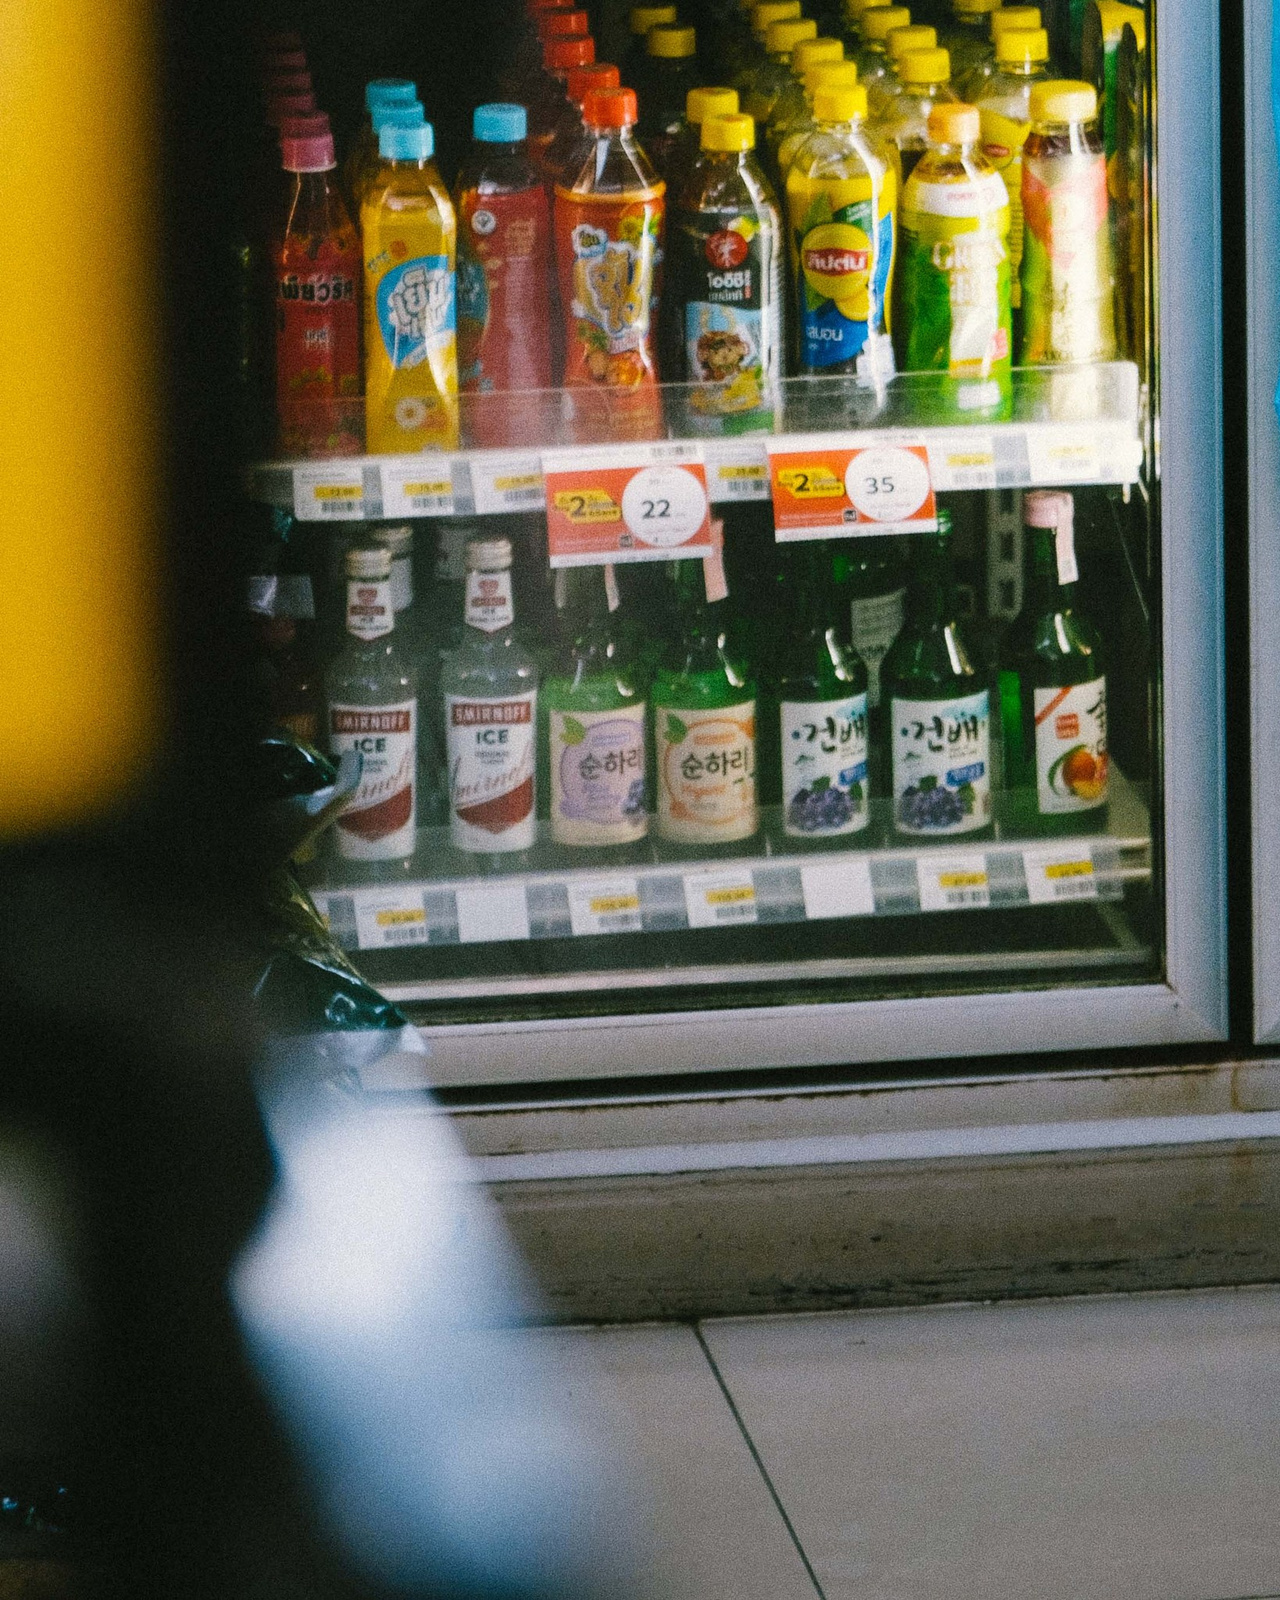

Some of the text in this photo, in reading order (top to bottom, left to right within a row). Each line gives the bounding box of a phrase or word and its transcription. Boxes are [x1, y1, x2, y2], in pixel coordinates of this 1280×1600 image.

[793, 473, 811, 493] 2
[865, 475, 895, 495] 35
[569, 496, 586, 517] 2
[641, 499, 671, 519] 22
[456, 703, 528, 722] SMIRNOFF
[353, 737, 386, 753] ICE
[476, 729, 509, 745] ICE
[680, 747, 749, 781] 순하리
